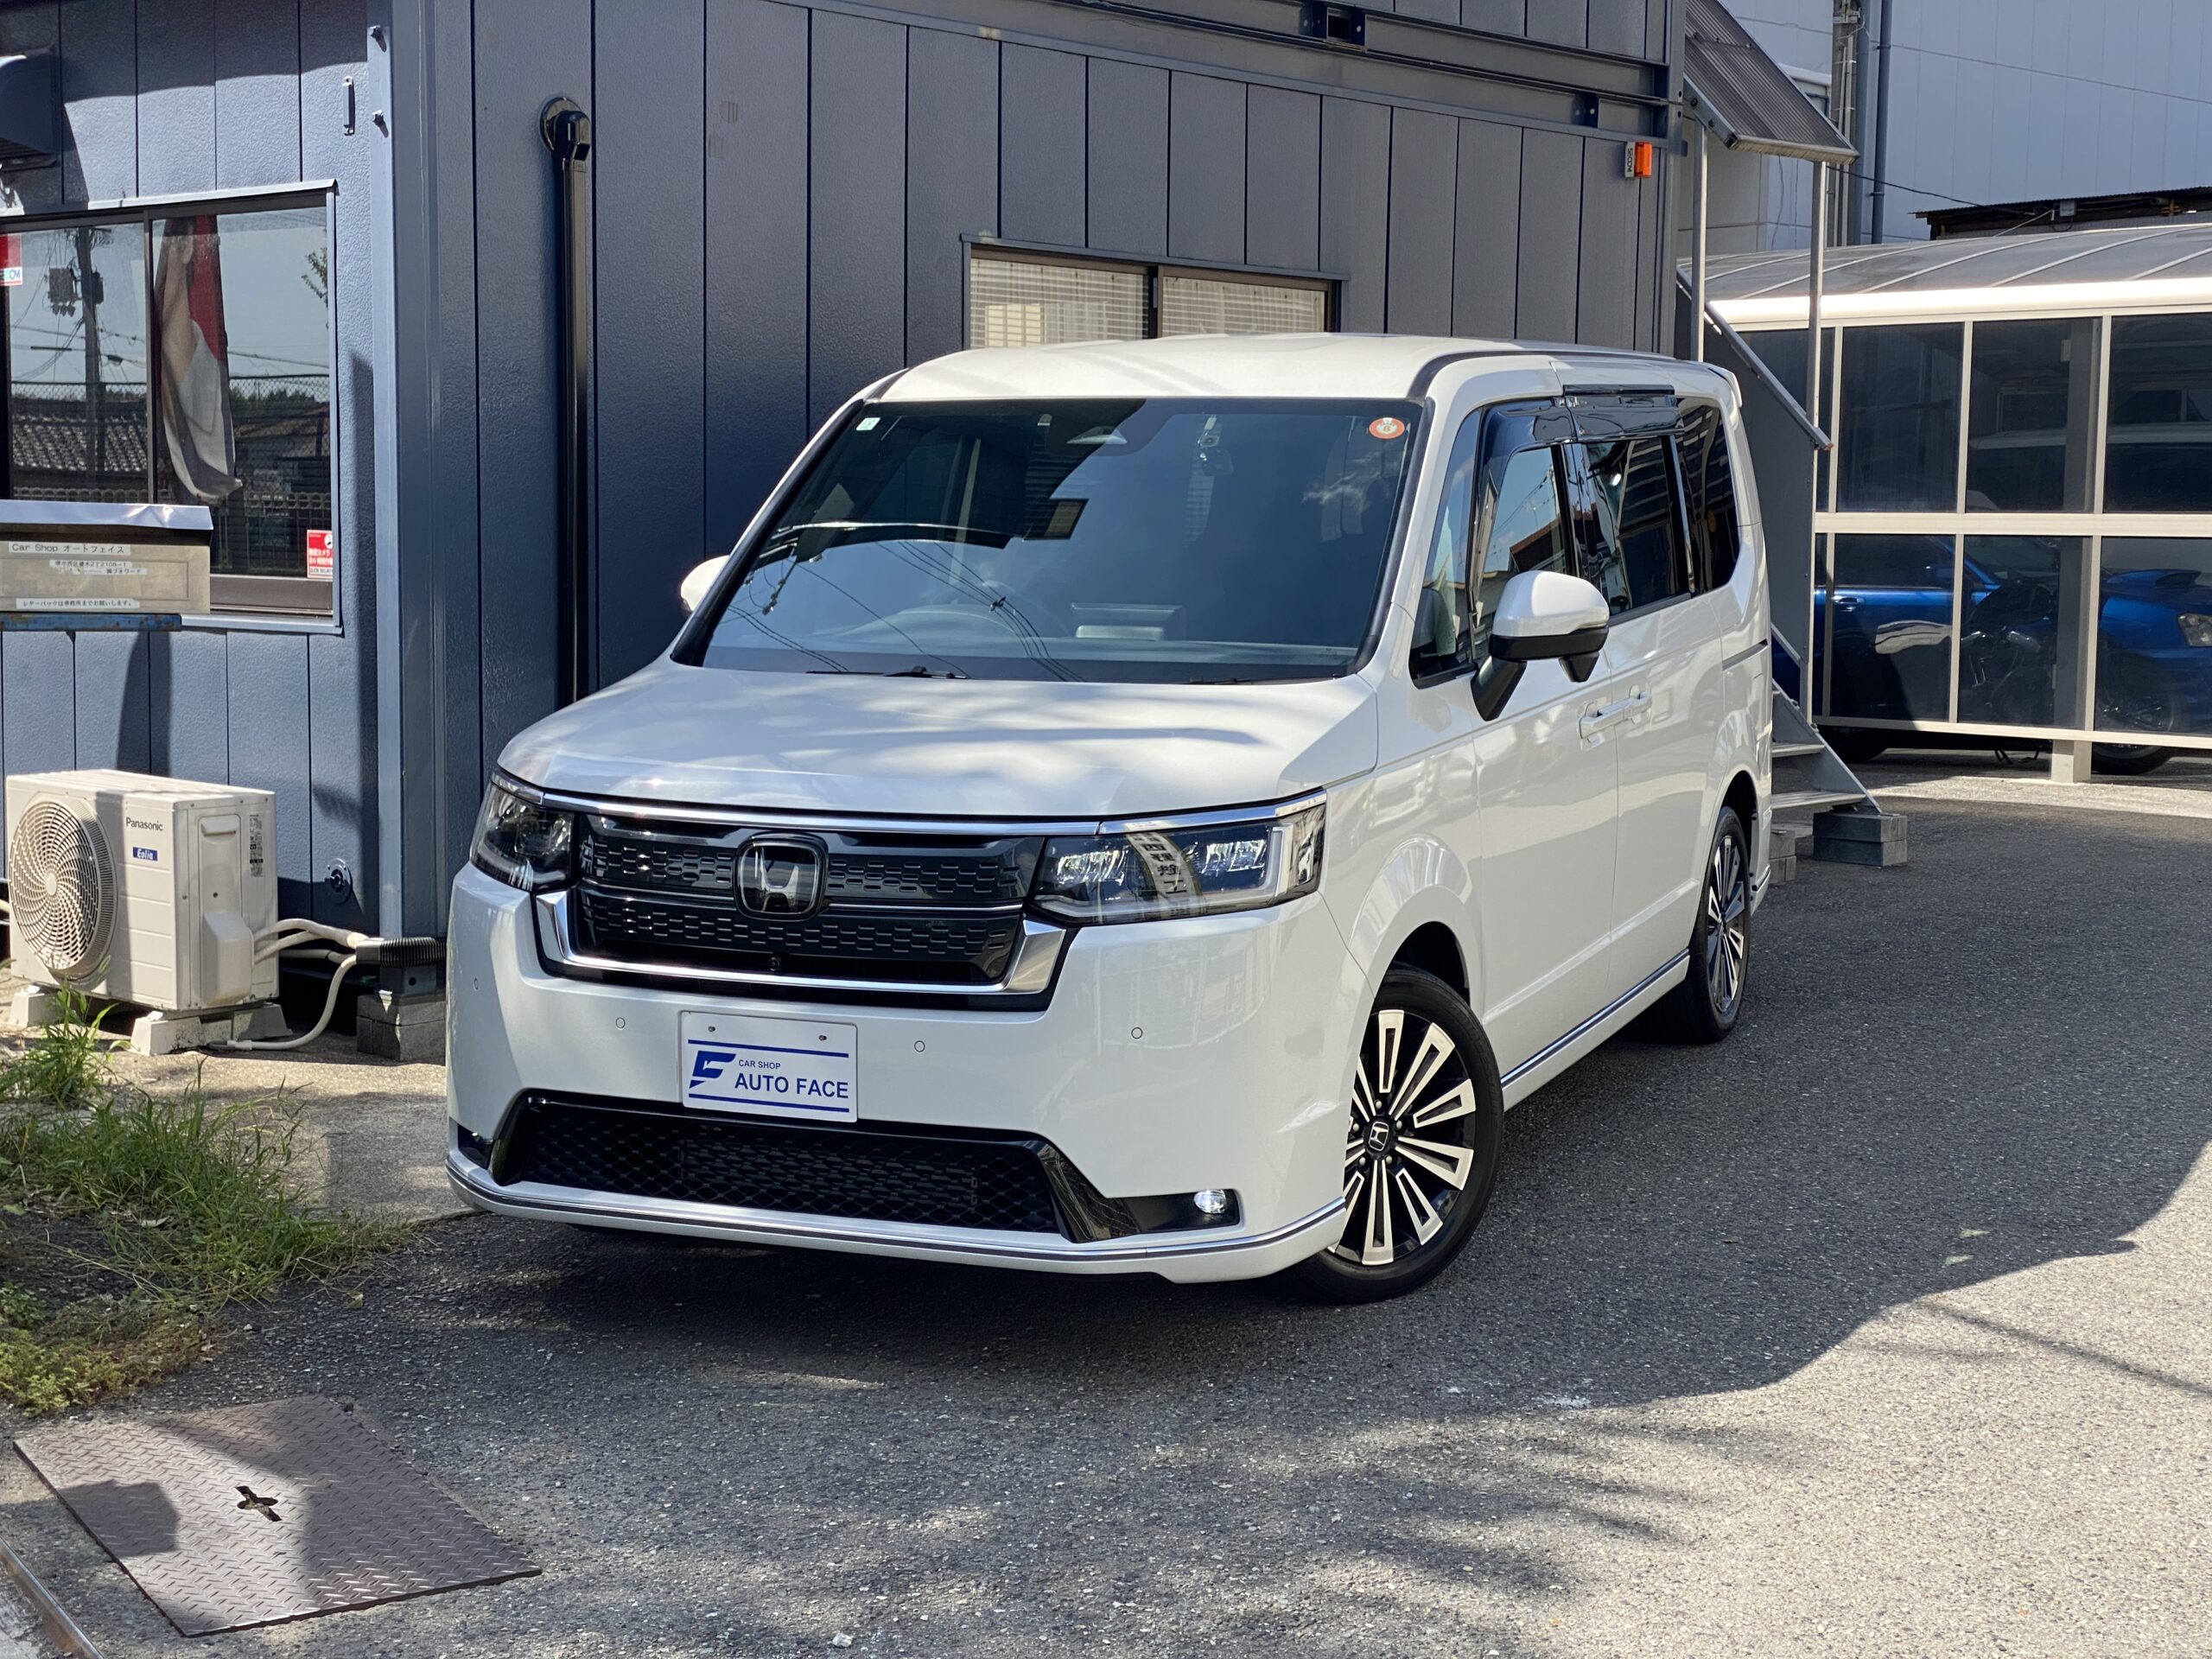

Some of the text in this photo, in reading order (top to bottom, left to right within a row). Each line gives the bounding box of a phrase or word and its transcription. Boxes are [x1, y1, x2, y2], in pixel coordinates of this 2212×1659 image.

[35, 543, 59, 552] Shop
[63, 544, 124, 553] オートフェイス
[125, 817, 164, 831] Panasonic
[137, 849, 154, 861] Eolia
[738, 1059, 781, 1070] CAR SHOP
[734, 1072, 849, 1099] AUTO FACE
